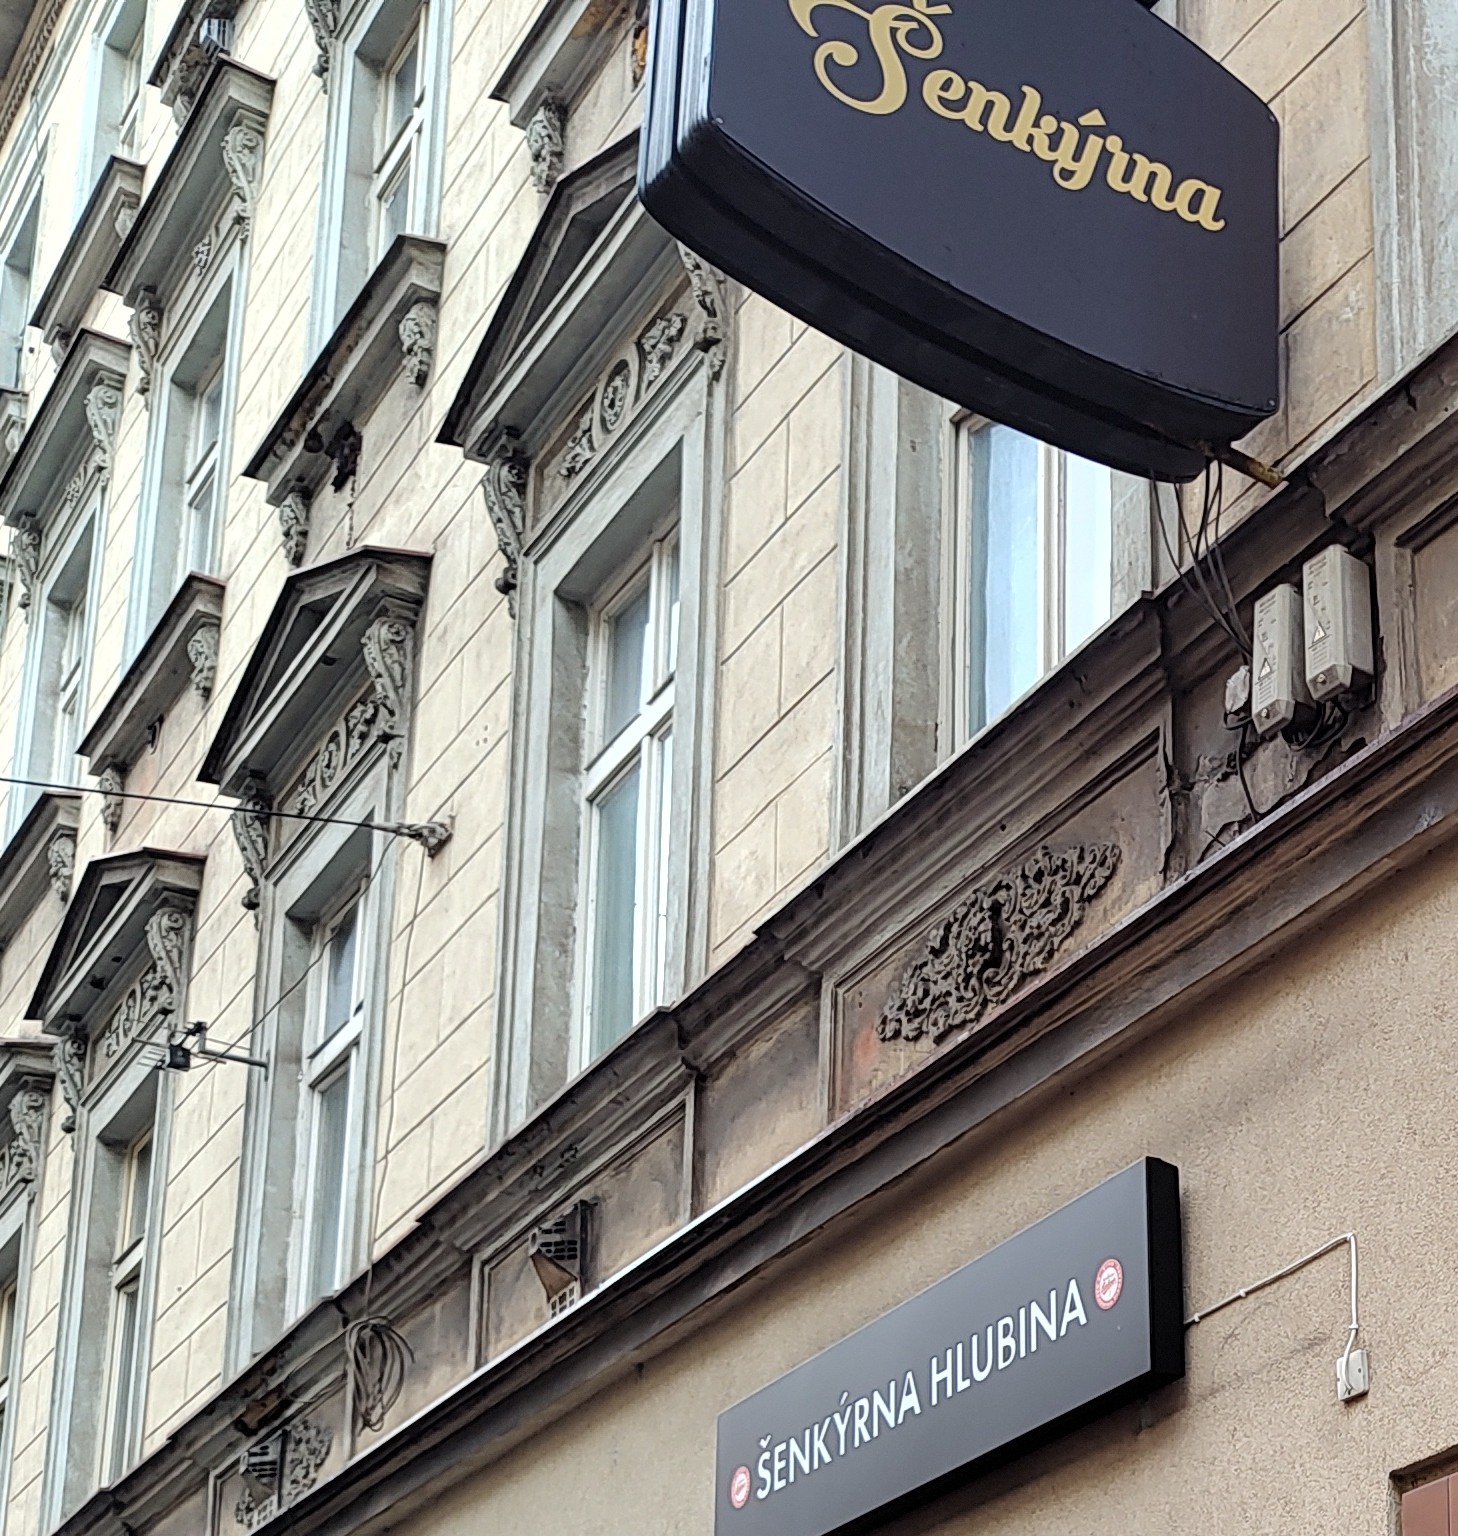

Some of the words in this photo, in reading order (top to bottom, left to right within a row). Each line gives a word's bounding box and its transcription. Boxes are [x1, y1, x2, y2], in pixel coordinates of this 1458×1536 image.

[788, 0, 1226, 232] Šenkýrna
[755, 1370, 922, 1501] ŠENKÝRNA
[930, 1277, 1088, 1407] HLUBINA
